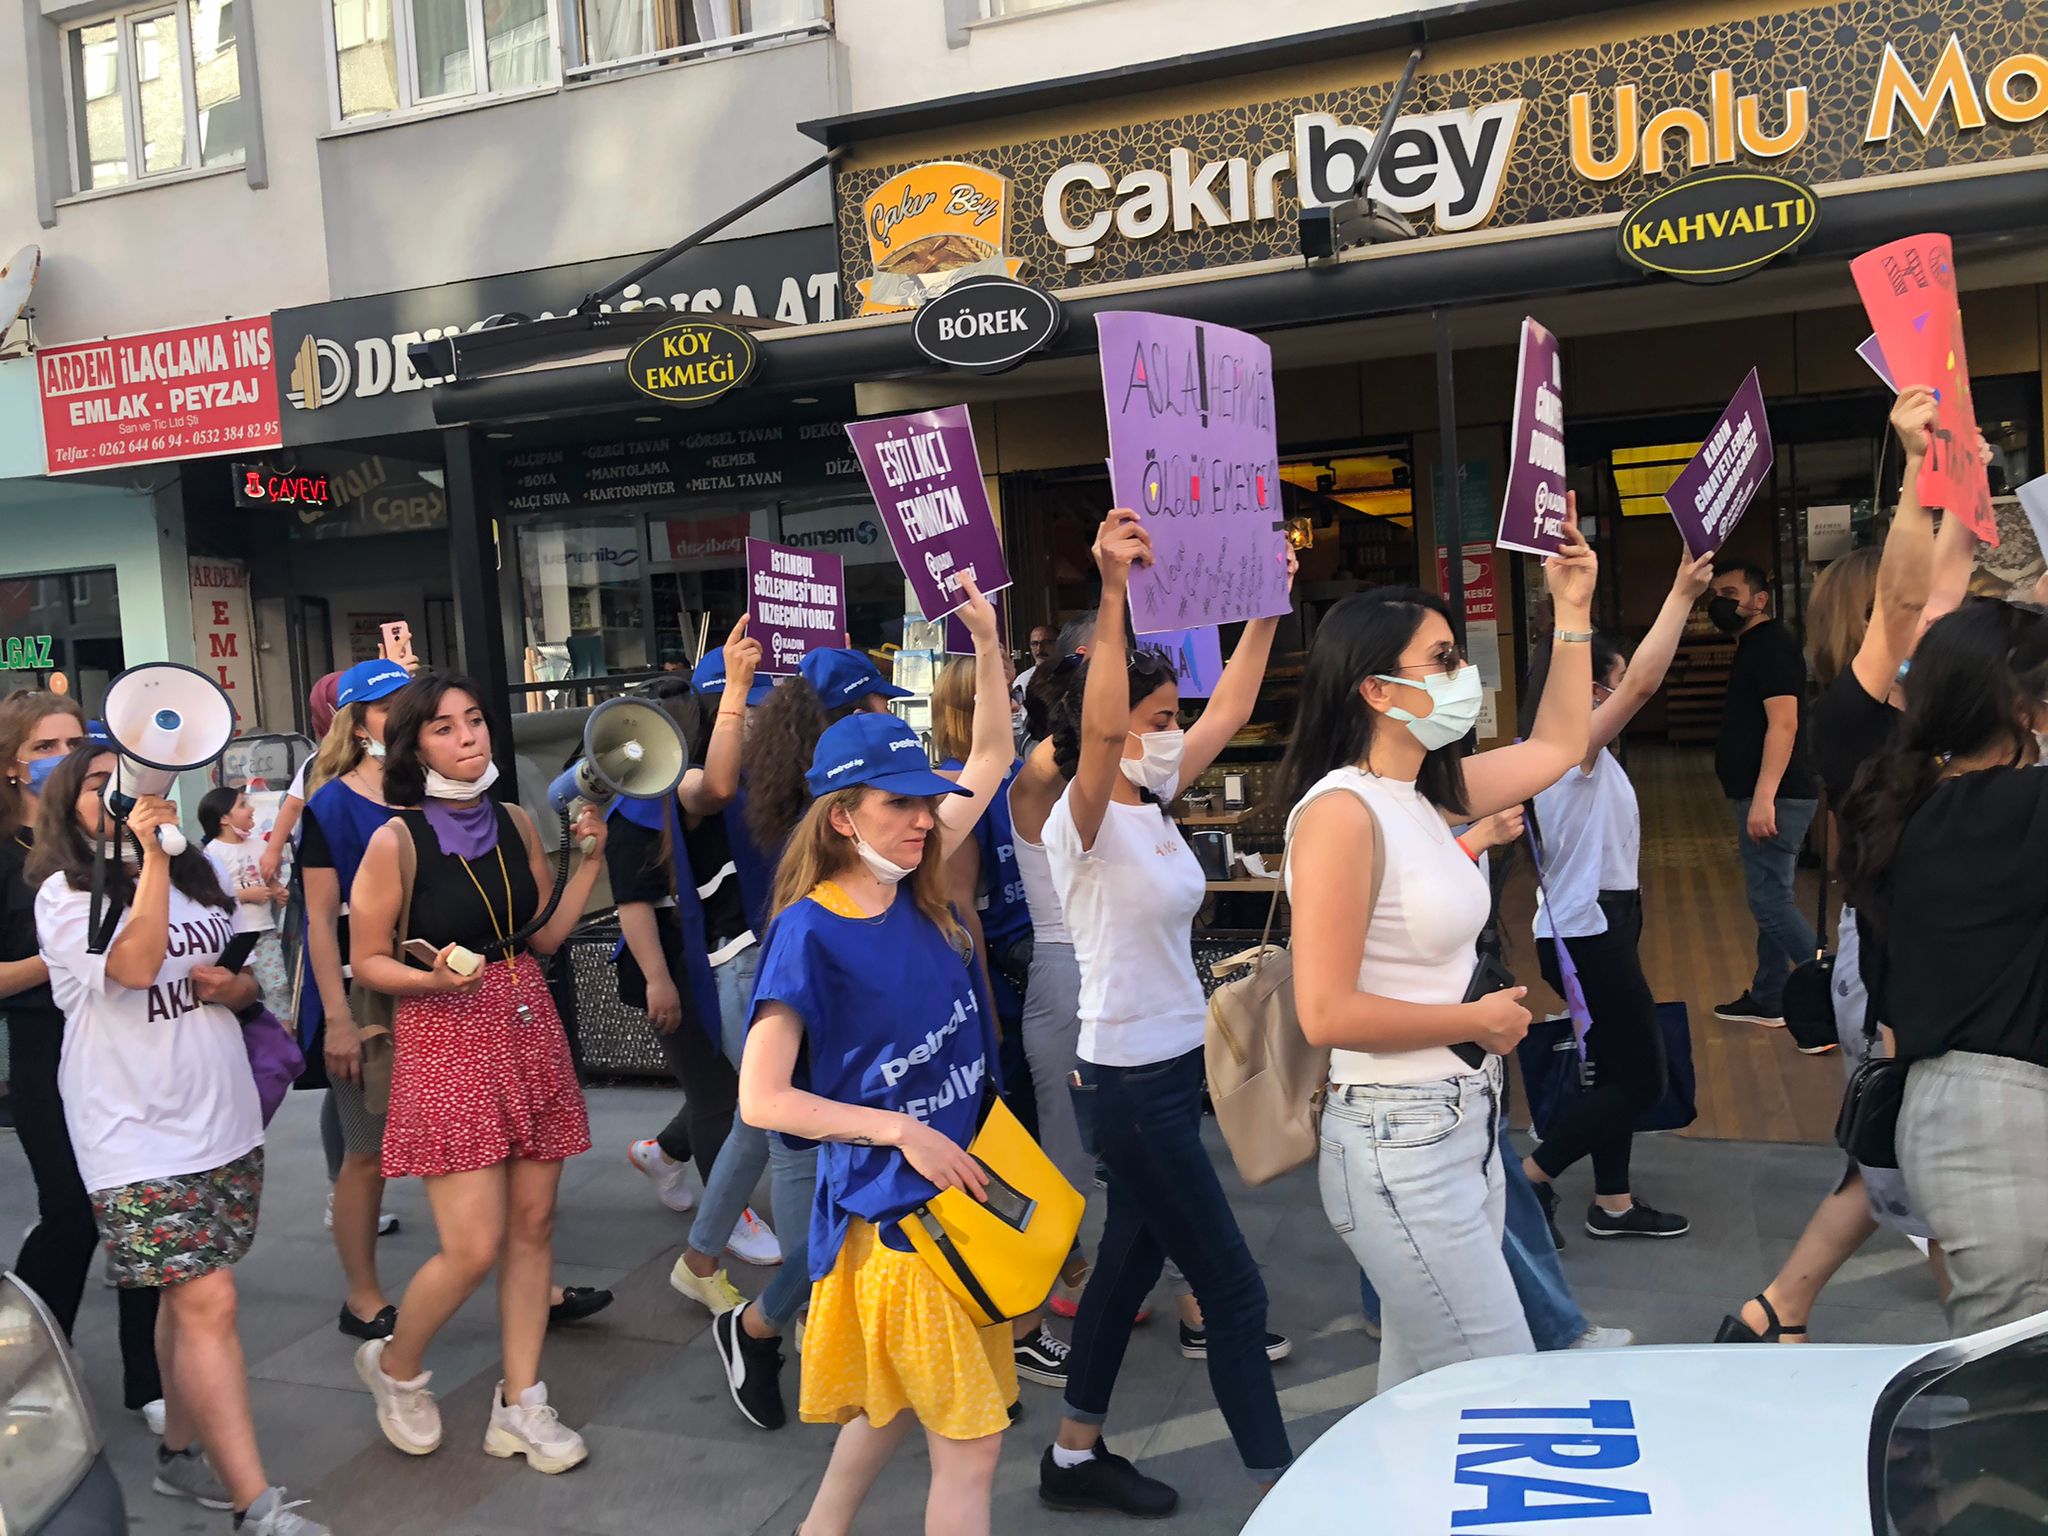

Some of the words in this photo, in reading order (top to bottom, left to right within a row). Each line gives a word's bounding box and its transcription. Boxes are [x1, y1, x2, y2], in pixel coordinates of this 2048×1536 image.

[1568, 68, 1808, 182] Unlu
[871, 184, 937, 248] Çakır
[945, 183, 999, 227] Bey
[1631, 198, 1807, 250] KAHVALTI
[938, 307, 1029, 343] BÖREK
[663, 328, 713, 358] KÖY
[46, 350, 115, 394] ARDEM
[119, 334, 229, 385] İLAÇLAMA
[646, 353, 735, 390] EKMEĞİ
[69, 392, 150, 427] EMLAK
[169, 377, 259, 413] PEYZAJ
[119, 422, 138, 435] San
[139, 422, 151, 433] ve
[169, 416, 184, 429] Ltd
[686, 432, 736, 449] GÖRSEL
[738, 426, 783, 444] TAVAN
[800, 421, 847, 441] DEKO
[55, 447, 89, 464] Telfax
[99, 441, 127, 457] 0262
[128, 438, 149, 453] 644
[152, 436, 166, 450] 66
[168, 434, 182, 448] 94
[193, 429, 220, 446] 0532
[223, 426, 244, 440] 384
[247, 424, 261, 438] 82
[264, 421, 279, 435] 95
[627, 438, 669, 455] TAVAN
[875, 421, 952, 492] EŞİTLİKÇİ
[591, 461, 671, 480] MANTOLAMA
[712, 453, 757, 468] KEMER
[268, 475, 329, 503] ÇAYEVİ
[524, 473, 557, 487] BOYA
[590, 481, 676, 502] KARTONPİYER
[692, 477, 735, 493] METAL
[737, 471, 783, 487] TAVAN
[514, 494, 541, 510] ALÇI
[543, 492, 571, 507] SIVA
[895, 483, 969, 545] FEMİNİZM
[194, 564, 244, 588] ARDEM
[771, 549, 815, 578] İSTANBUL
[754, 570, 838, 606] SÖZLEŞMESİ'NDEN
[758, 601, 836, 630] VAZGEÇMİYORUZ
[782, 637, 805, 650] KADIN
[1450, 1400, 1652, 1536] TRA
